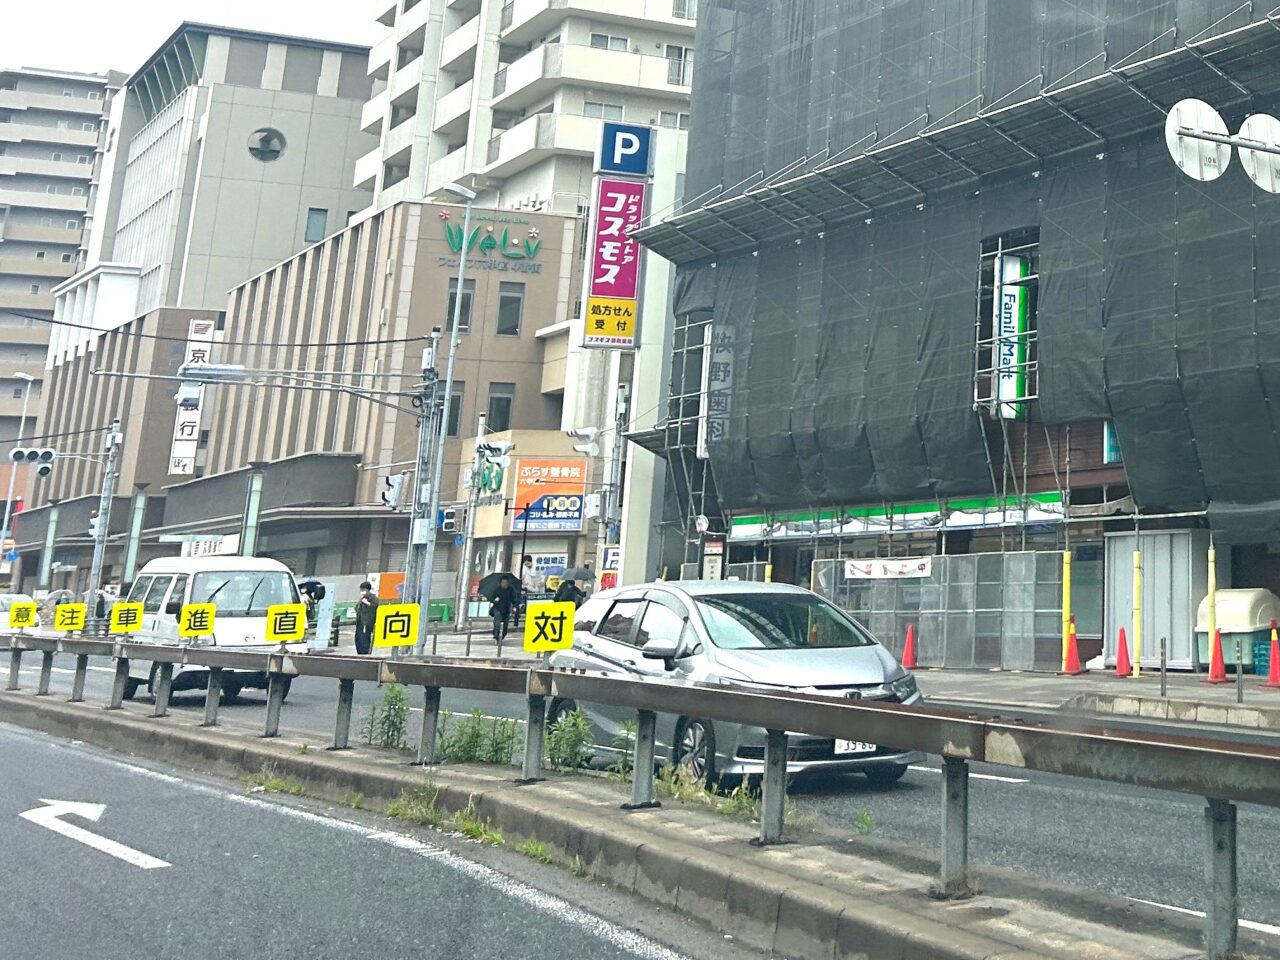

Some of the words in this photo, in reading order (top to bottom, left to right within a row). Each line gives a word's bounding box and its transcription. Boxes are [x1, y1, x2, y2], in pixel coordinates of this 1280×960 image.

[613, 131, 640, 165] P
[594, 192, 627, 285] コスモス
[591, 304, 633, 317] 処方せん
[12, 606, 33, 623] 意
[59, 608, 81, 627] 注
[116, 607, 139, 628] 車
[185, 609, 210, 632] 進
[273, 610, 299, 635] 直
[382, 610, 411, 641] 向
[532, 610, 567, 643] 対
